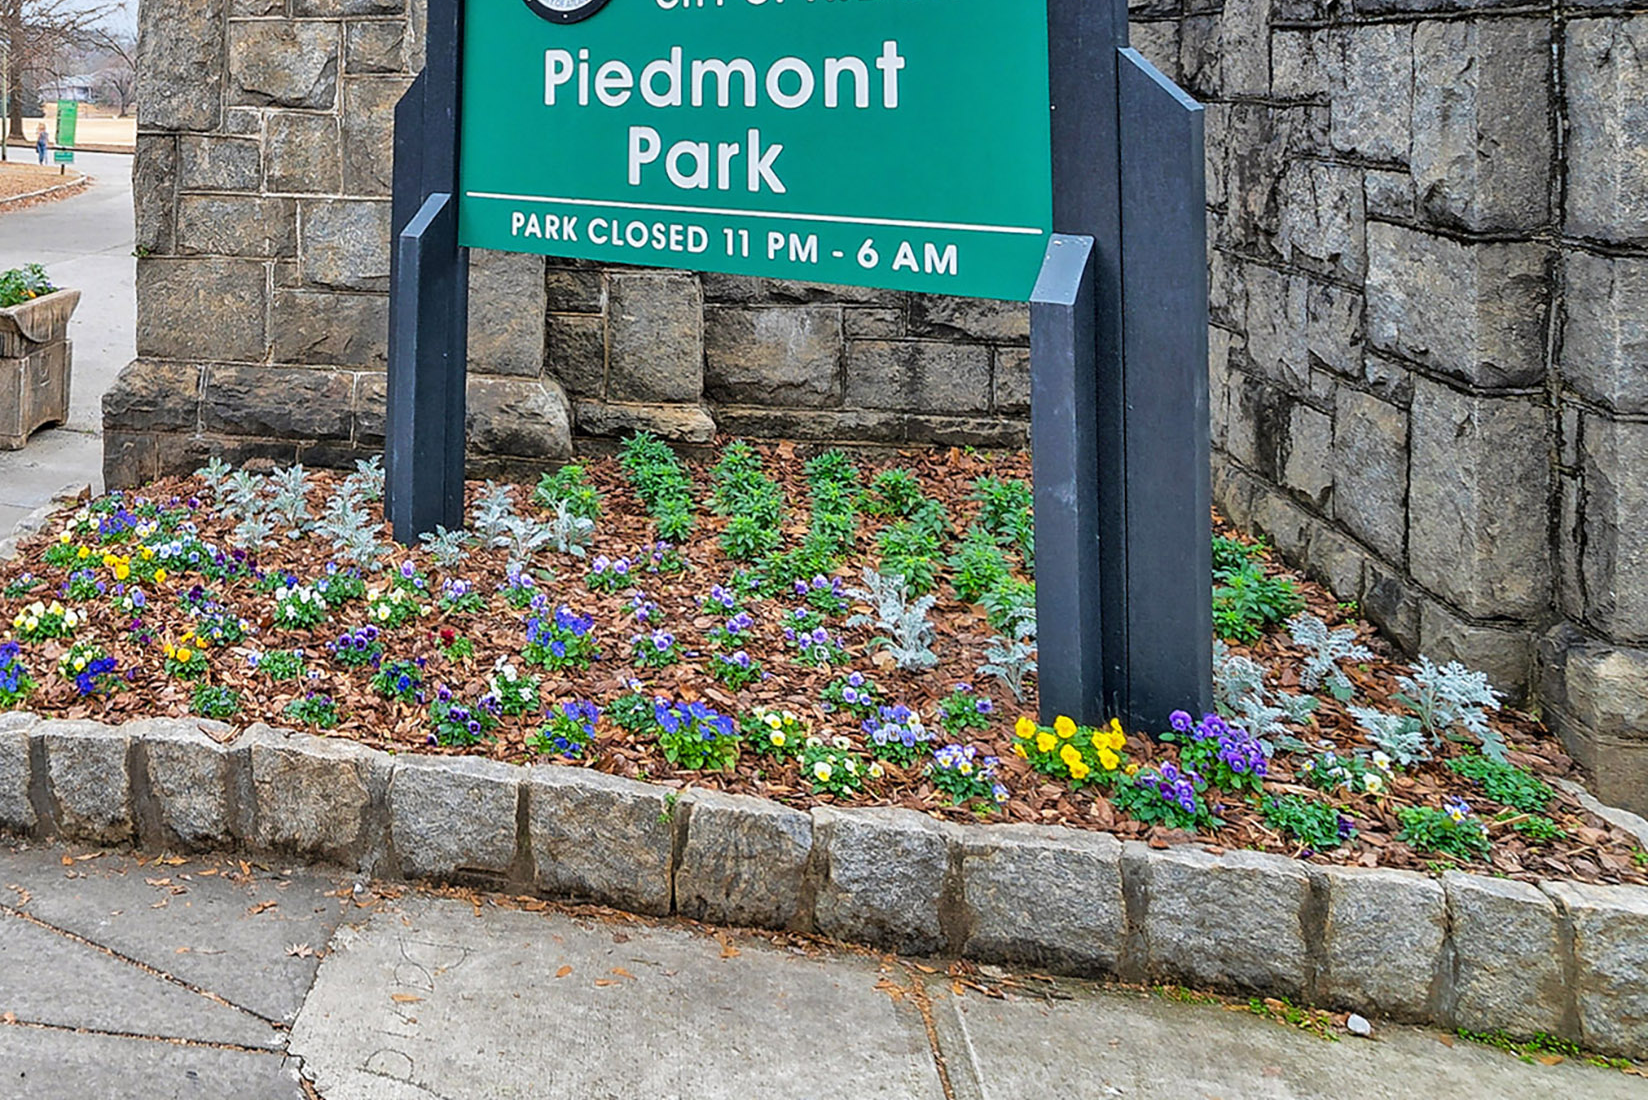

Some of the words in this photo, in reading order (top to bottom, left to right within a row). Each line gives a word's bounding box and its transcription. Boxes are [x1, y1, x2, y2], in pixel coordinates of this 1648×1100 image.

[543, 41, 905, 109] Piedmont
[628, 126, 786, 193] Park
[511, 212, 578, 241] PARK
[588, 218, 709, 253] CLOSED
[723, 228, 750, 257] 11
[767, 232, 818, 263] PM
[832, 250, 844, 258] -
[856, 238, 879, 269] 6
[891, 242, 958, 275] AM
